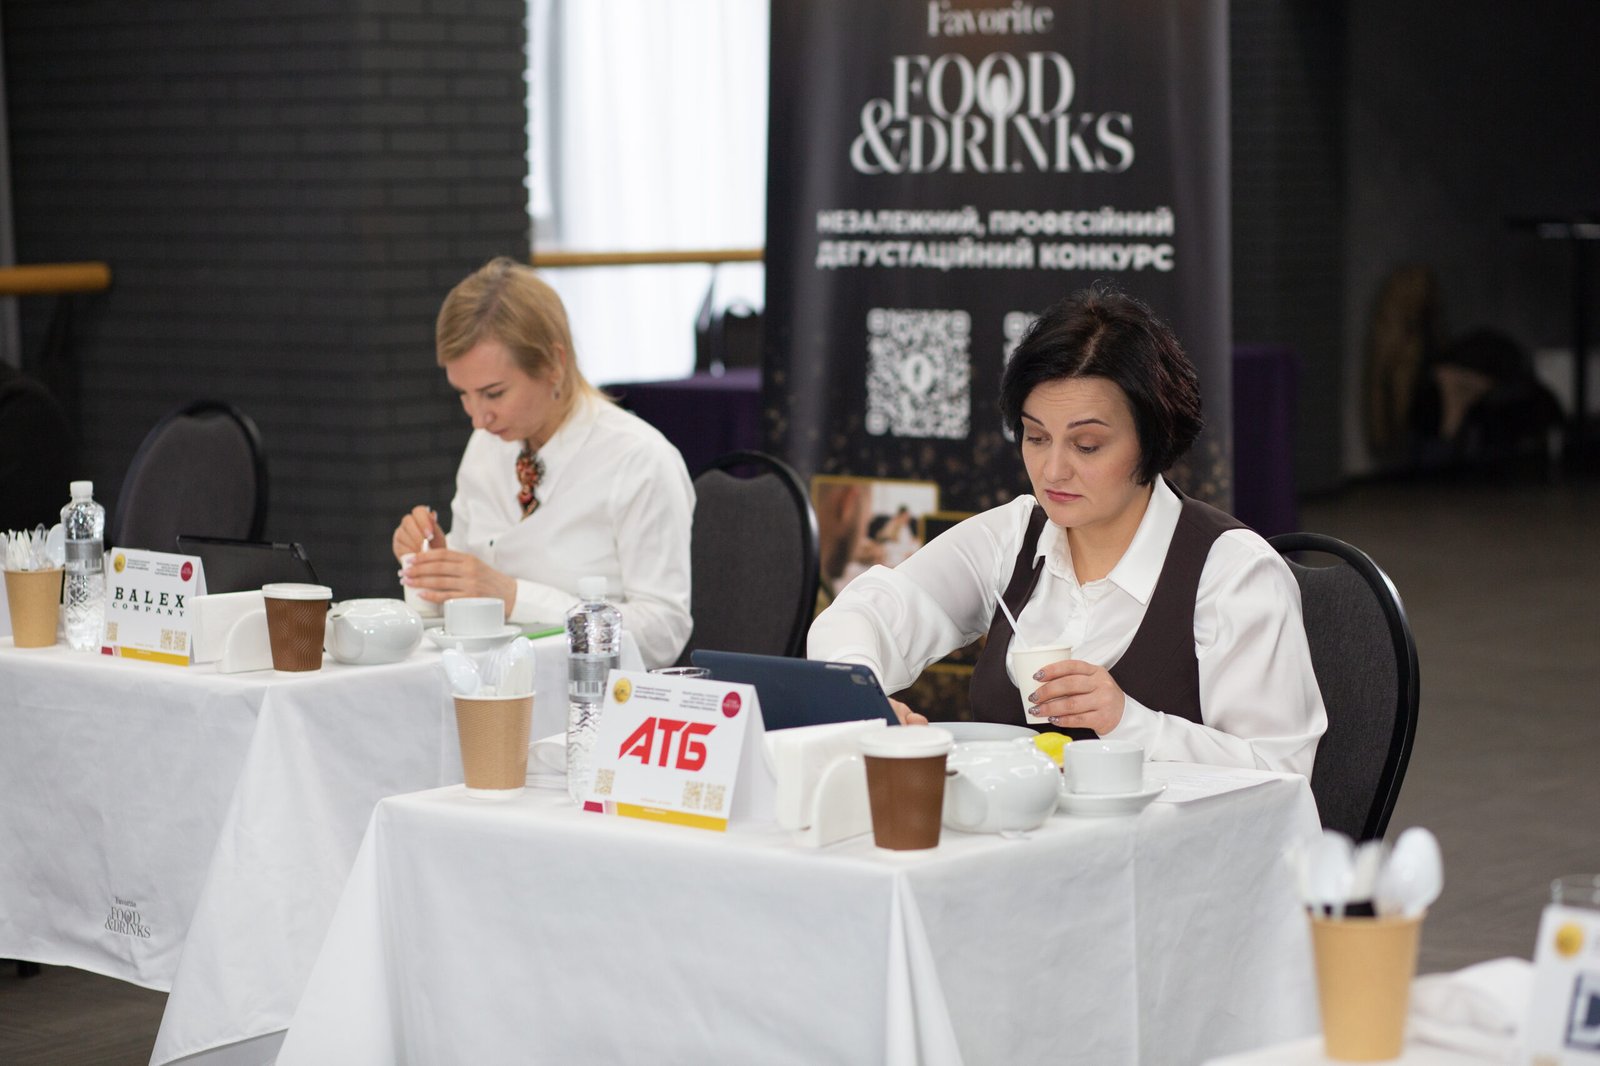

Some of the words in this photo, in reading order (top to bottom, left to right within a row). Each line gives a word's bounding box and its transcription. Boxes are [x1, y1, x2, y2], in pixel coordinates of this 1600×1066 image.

[926, 0, 1054, 37] Favorite
[891, 51, 1075, 122] FOOD
[849, 98, 1136, 175] &DRINKS
[816, 206, 986, 236] НЕЗАЛЕЖНИЙ,
[988, 206, 1175, 236] ПРОФЕСІЙНИЙ
[815, 237, 1034, 271] ДЕГУСТАЦІЙНИЙ
[1039, 243, 1175, 271] КОНКУРС
[112, 602, 185, 617] COMPANY
[115, 586, 185, 608] BALEX
[104, 914, 151, 938] &DRINKS
[111, 906, 141, 926] FOOD
